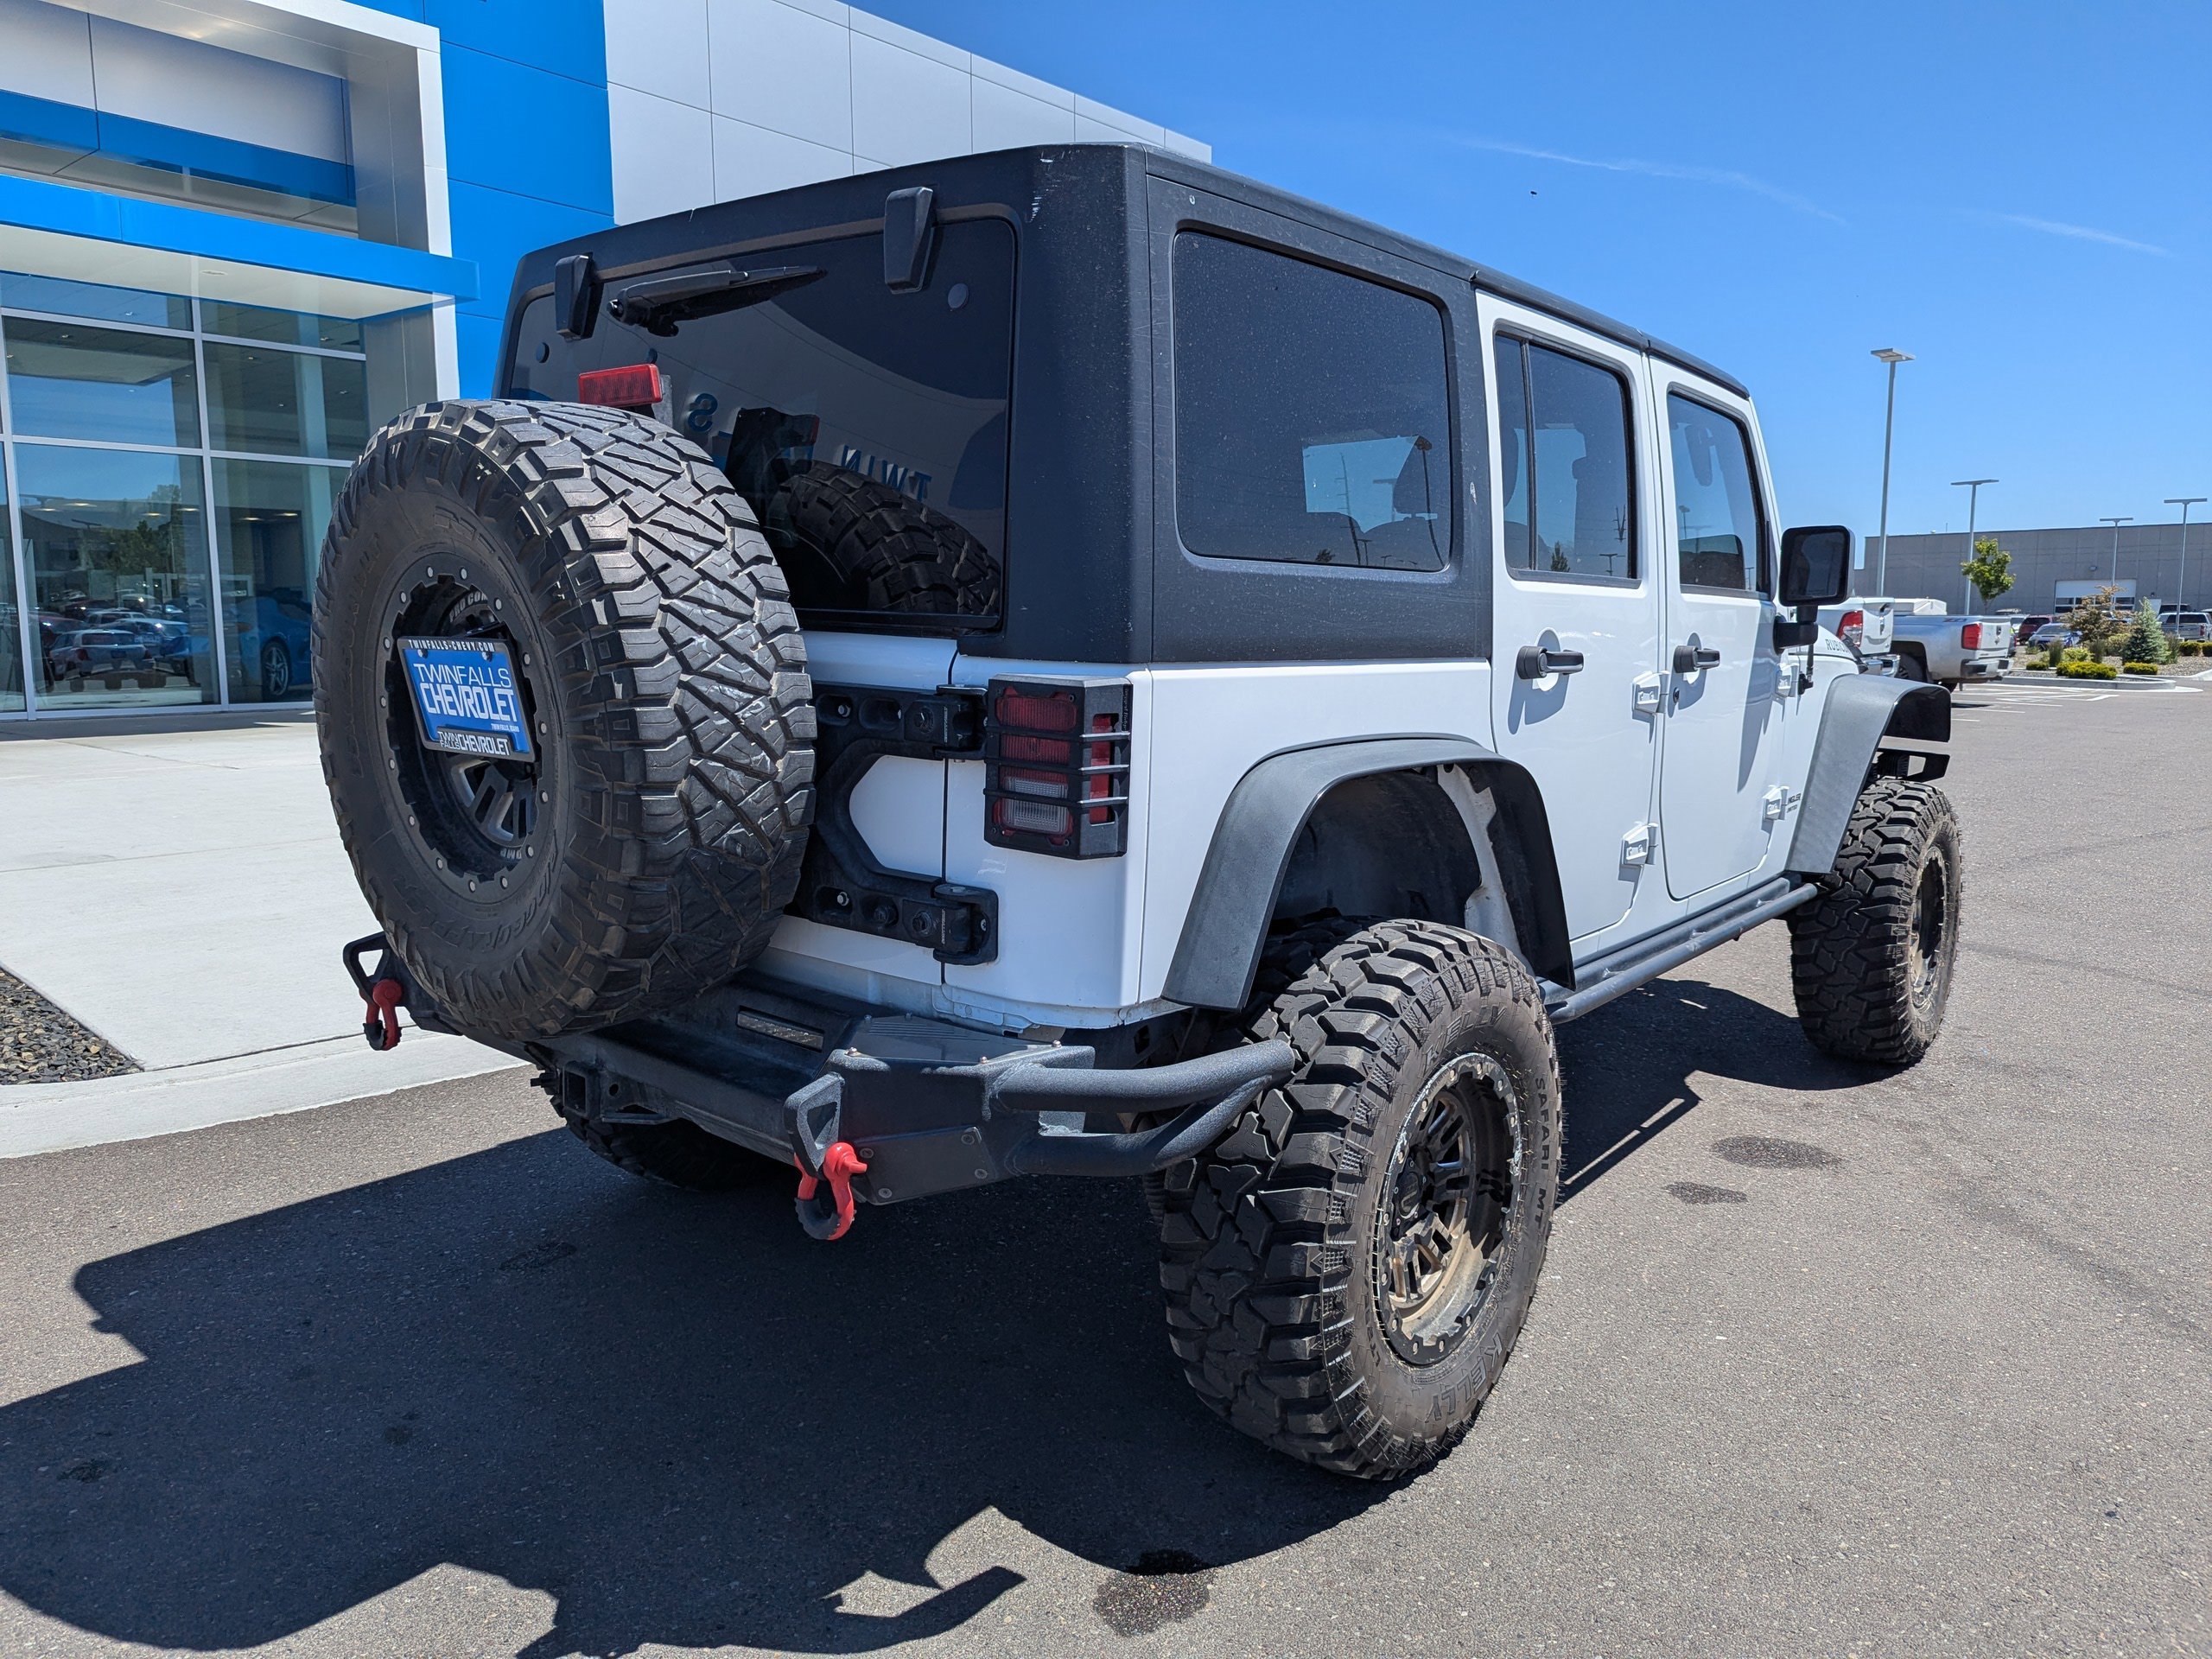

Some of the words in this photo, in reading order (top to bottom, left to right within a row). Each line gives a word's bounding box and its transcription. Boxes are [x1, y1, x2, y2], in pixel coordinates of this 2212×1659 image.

[467, 591, 489, 606] COM
[420, 683, 518, 721] CHEVROLET
[437, 731, 460, 742] TWIN
[440, 741, 461, 750] FALLS
[459, 734, 509, 755] CHEVROLET
[1421, 1005, 1506, 1070] KELLY
[1535, 1077, 1550, 1171] SAFARI
[1534, 1187, 1548, 1230] MT
[1425, 1332, 1503, 1424] KELLY
